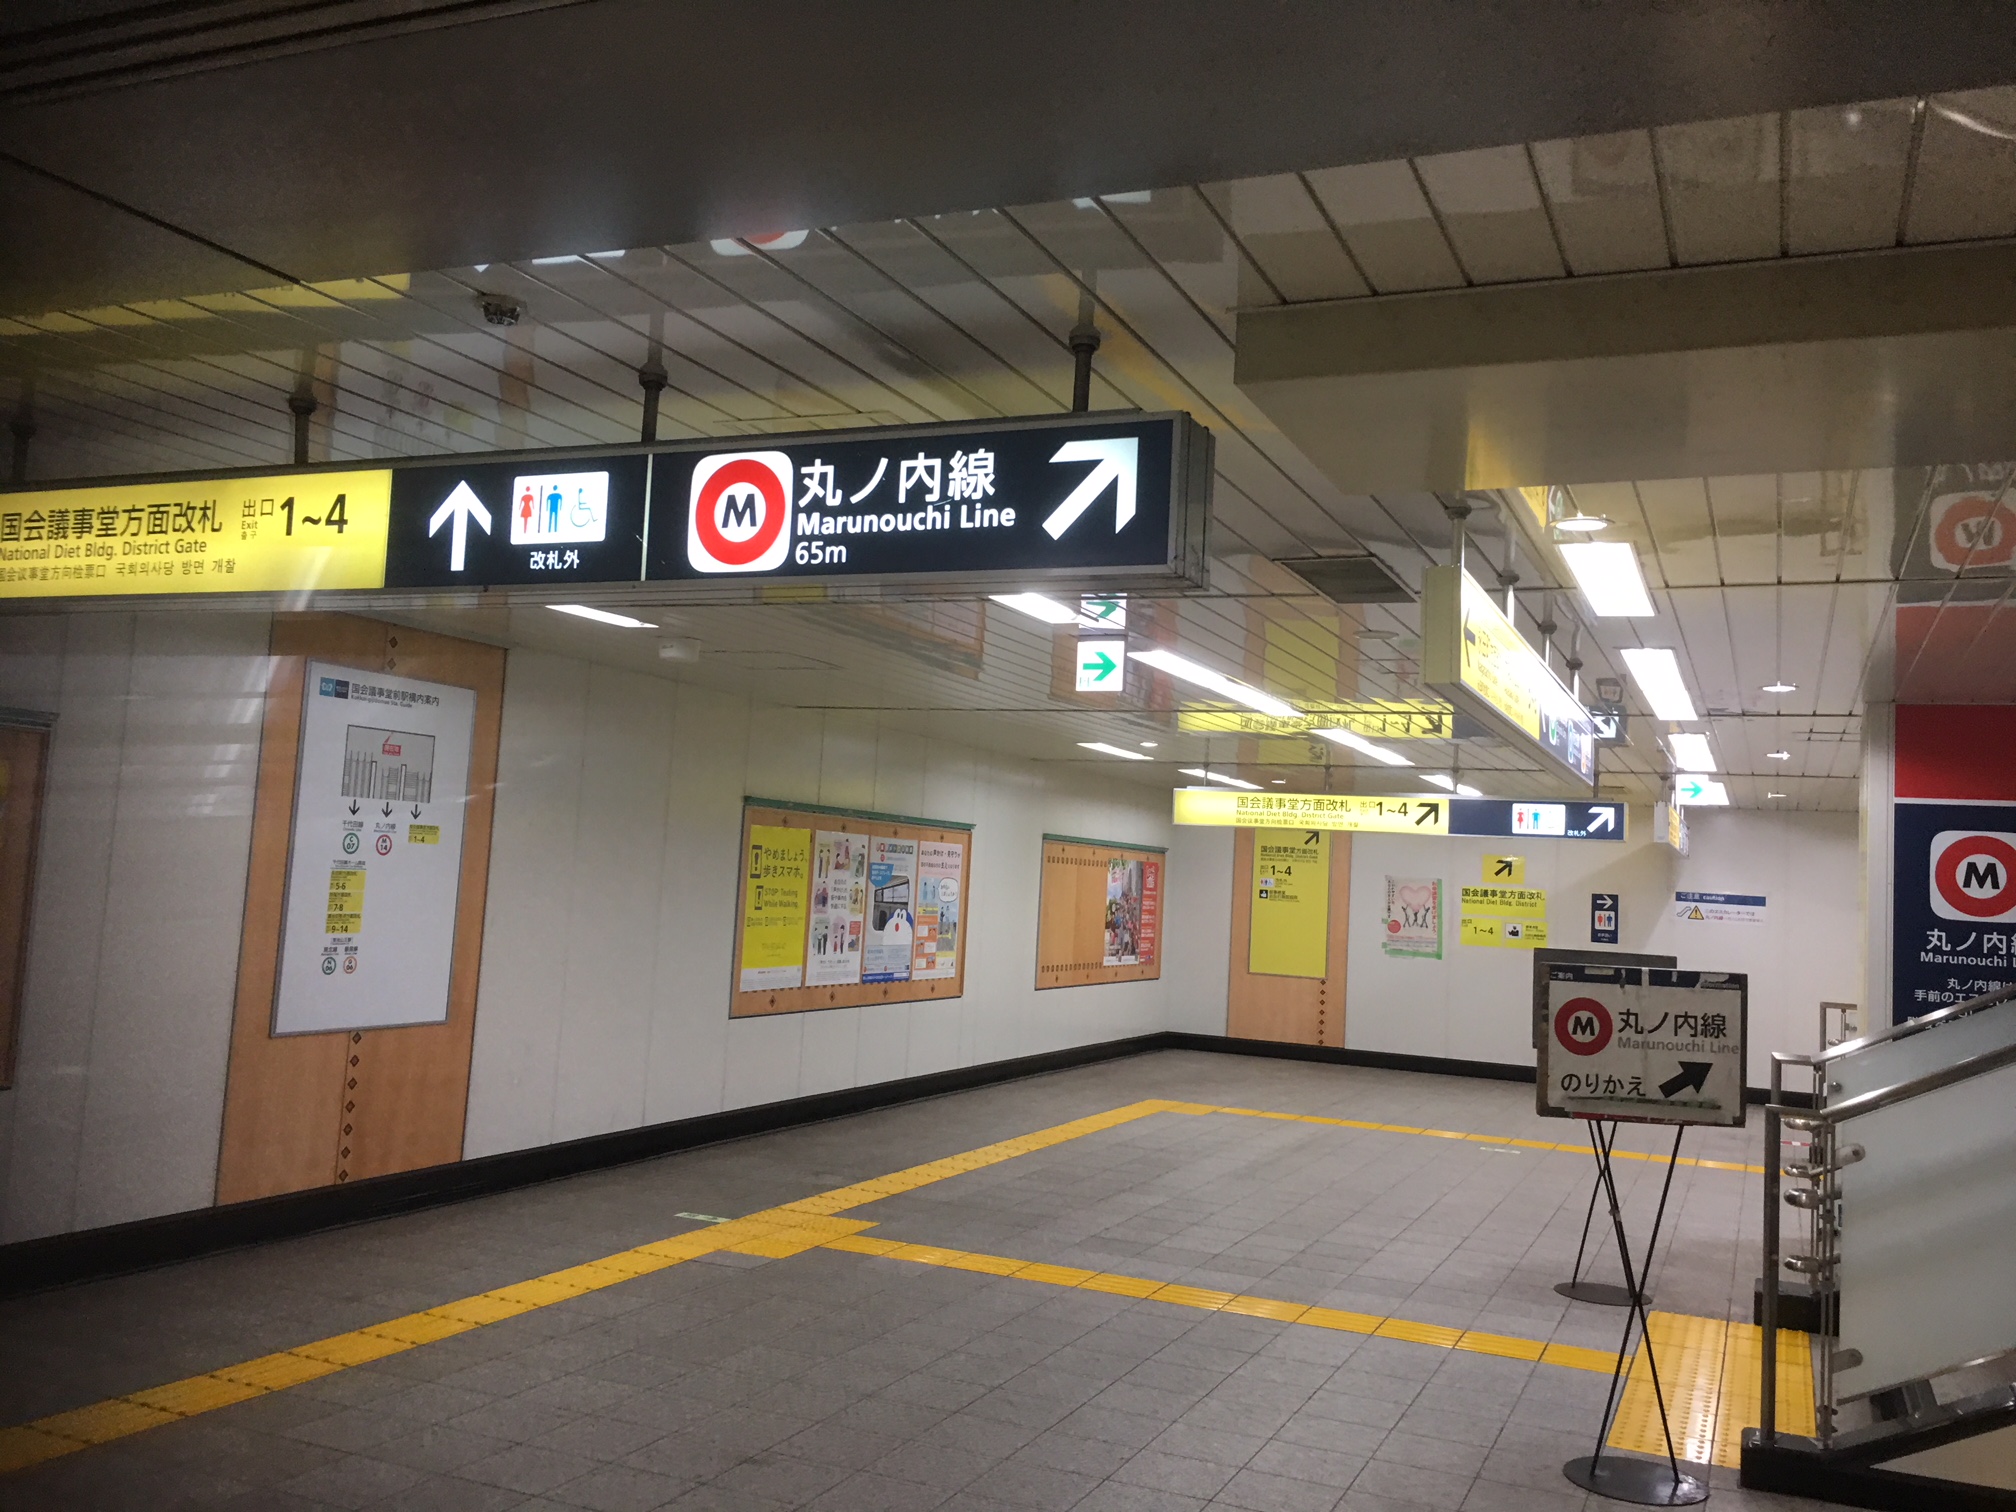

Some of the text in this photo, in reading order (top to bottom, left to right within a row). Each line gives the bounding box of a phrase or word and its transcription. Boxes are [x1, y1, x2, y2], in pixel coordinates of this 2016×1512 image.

[797, 448, 996, 508] 丸ノ内線
[242, 498, 275, 518] 出口
[721, 493, 758, 529] M
[1, 499, 223, 542] 国会議事堂方面改札
[241, 519, 258, 530] Exit
[796, 502, 1016, 536] Marunouchi Line
[0, 538, 207, 561] National Diet Bldg. District Gate
[529, 549, 580, 570] 改札外
[795, 540, 848, 565] 65m
[182, 559, 205, 575] 방면
[211, 558, 236, 574] 개찰
[1237, 796, 1351, 813] 国会議事堂方面改札
[1567, 829, 1587, 837] 改札外
[346, 842, 355, 850] 07
[763, 864, 804, 879] 歩きスマホ。
[1962, 861, 2000, 890] M
[1461, 887, 1545, 901] 国会議事堂方面改札
[1516, 900, 1537, 908] District
[1926, 928, 2016, 955] 丸ノ内
[1920, 951, 2008, 967] Marunouchi
[1571, 1015, 1596, 1037] M
[1617, 1008, 1727, 1039] 丸ノ内線
[1617, 1036, 1740, 1055] Marunouchi Line
[1560, 1073, 1647, 1097] のりかえ
